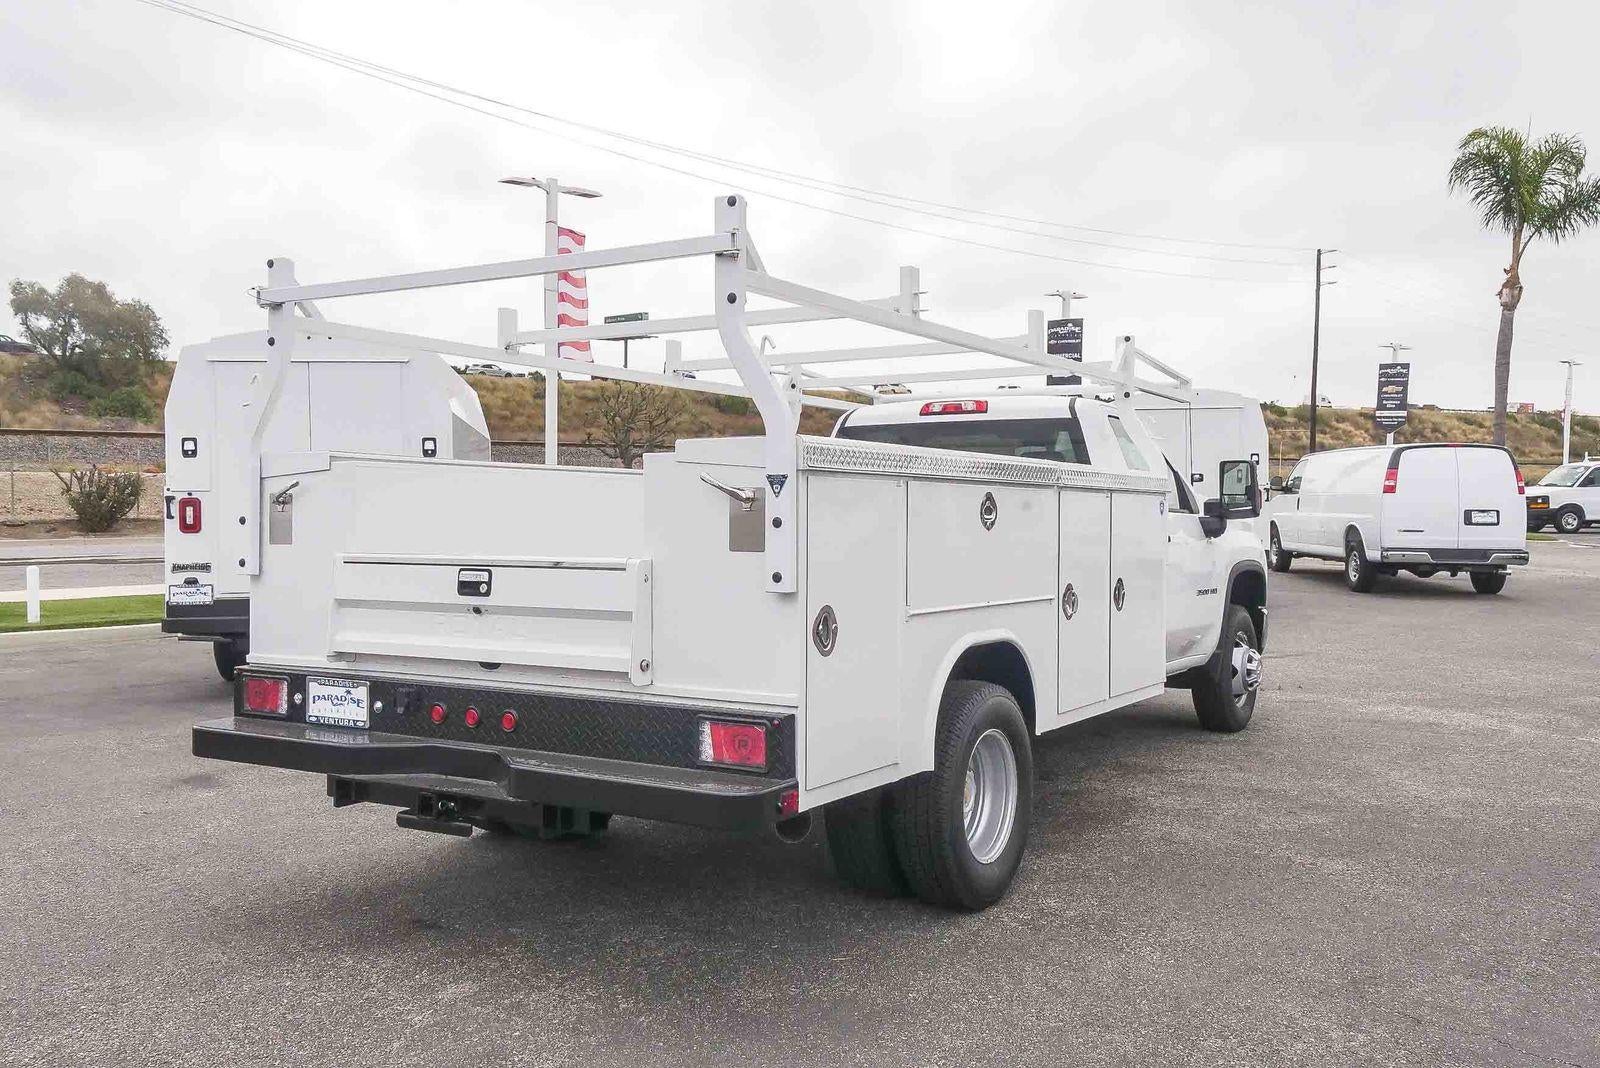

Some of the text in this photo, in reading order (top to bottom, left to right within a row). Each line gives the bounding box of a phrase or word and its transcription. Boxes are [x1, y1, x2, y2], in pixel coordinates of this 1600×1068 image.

[171, 562, 212, 574] KNAPHEIDE
[318, 679, 354, 688] PARADISE
[312, 692, 366, 709] PARADISE
[320, 717, 355, 727] VENTURA
